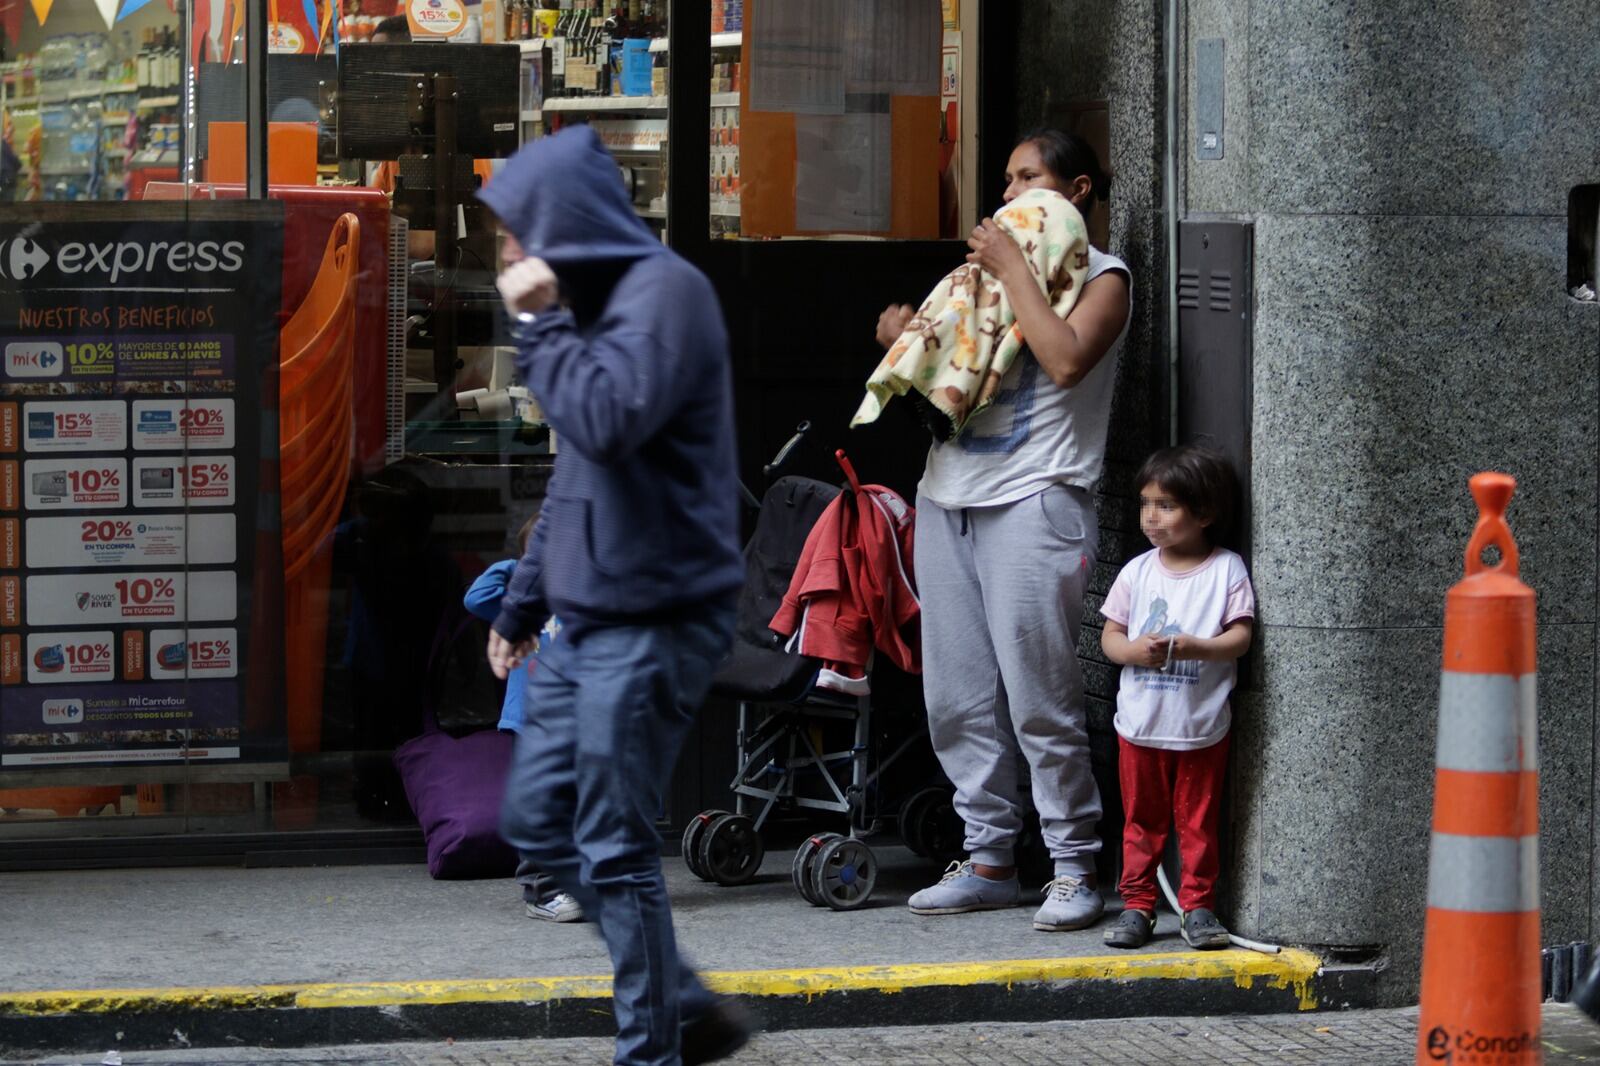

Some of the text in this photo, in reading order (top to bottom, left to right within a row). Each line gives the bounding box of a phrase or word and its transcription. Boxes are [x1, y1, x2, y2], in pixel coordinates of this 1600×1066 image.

[56, 240, 245, 284] express
[19, 304, 215, 329] NUESTROS BENEFICIOS
[65, 342, 114, 365] 10%
[118, 342, 164, 351] MAYORES
[164, 342, 176, 350] DE
[118, 350, 222, 360] DE LUNES A JUEVES
[13, 352, 29, 366] mi
[4, 408, 13, 447] MARTES
[56, 412, 93, 430] 15%
[179, 408, 223, 427] 20%
[68, 469, 120, 492] 10%
[177, 463, 229, 488] 15%
[81, 520, 132, 542] 20%
[5, 580, 15, 622] JUEVES
[115, 577, 175, 605] 10%
[65, 643, 111, 665] 10%
[189, 640, 231, 660] 15%
[47, 706, 60, 717] mi
[128, 695, 141, 706] mi
[142, 696, 185, 706] Carrefour
